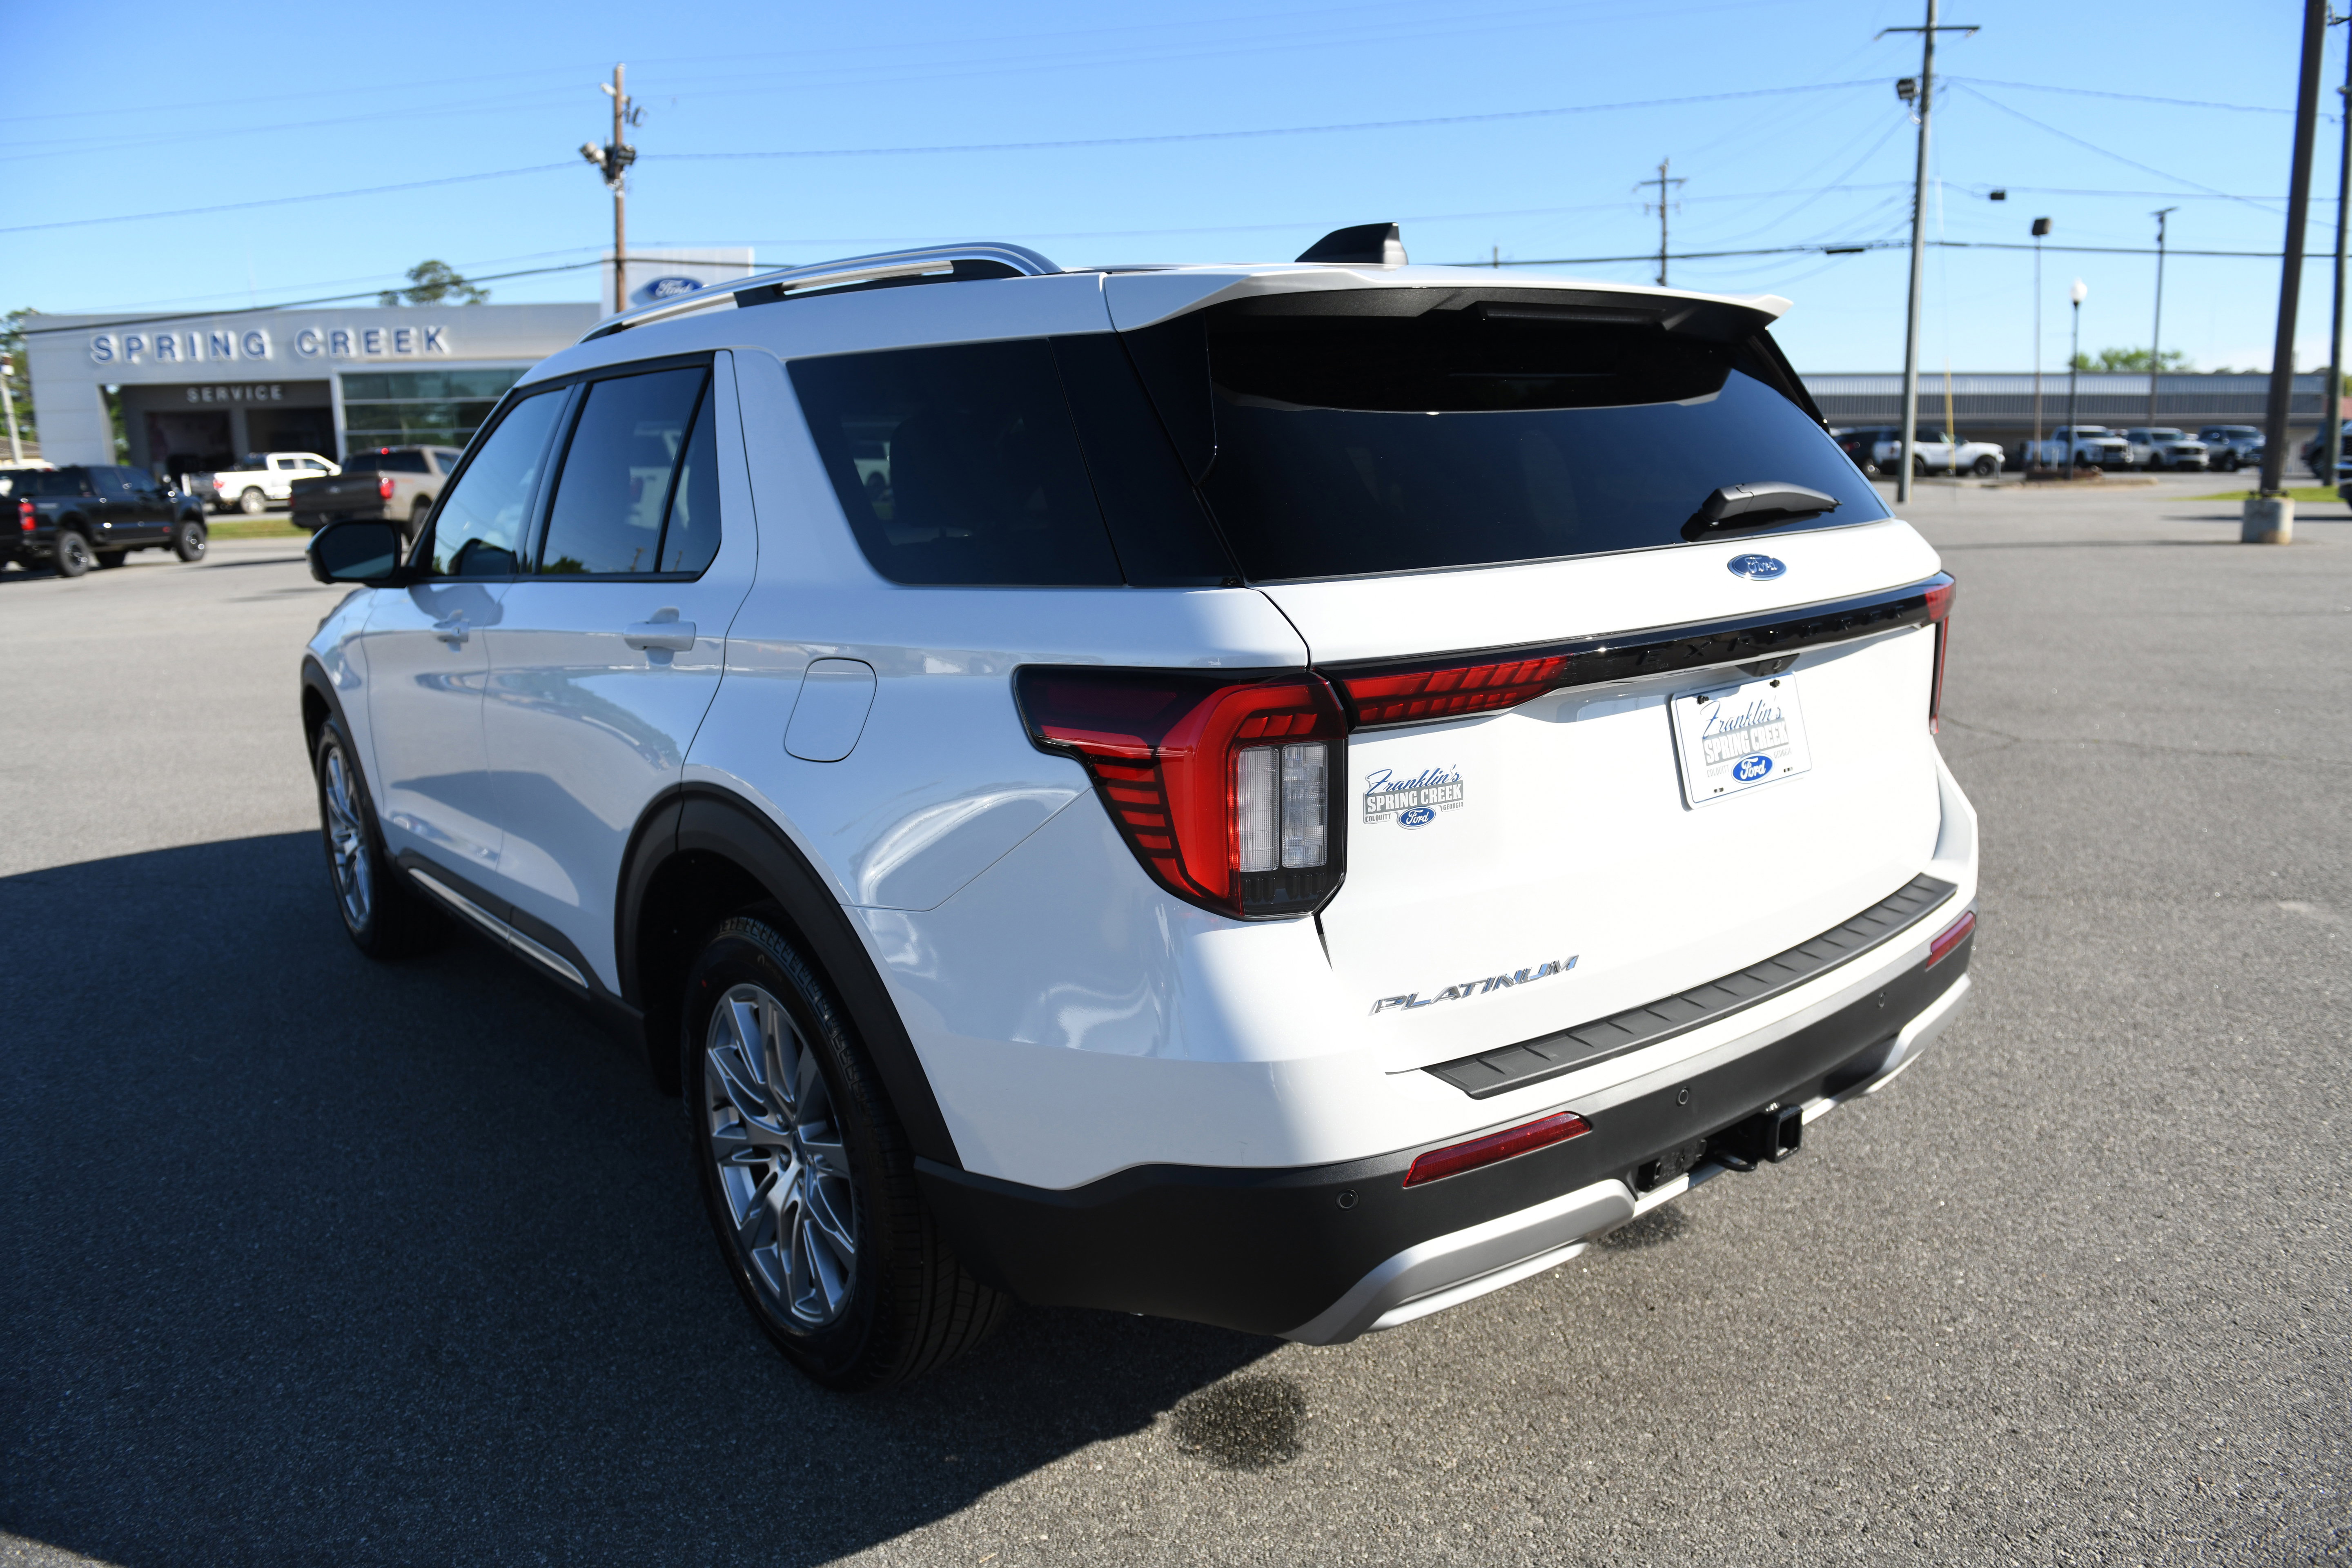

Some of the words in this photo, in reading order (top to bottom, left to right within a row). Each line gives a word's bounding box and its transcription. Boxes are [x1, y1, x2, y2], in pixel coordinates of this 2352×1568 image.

[90, 329, 273, 365] SPRING
[294, 326, 451, 359] CREEK
[187, 385, 284, 403] SERVICE
[1744, 556, 1778, 574] Ford
[1700, 695, 1782, 739] Franklin's
[1704, 731, 1751, 764] SPRING
[1750, 721, 1789, 751] CREEK
[1707, 764, 1729, 777] COLQUITT
[1774, 748, 1792, 759] GEORGIA
[1740, 757, 1766, 780] Ford
[1366, 764, 1462, 796] Franklin's
[1365, 813, 1392, 822] COLQUITT
[1443, 801, 1464, 810] GEORGIA
[1367, 790, 1418, 813] SPRING
[1421, 783, 1462, 806] CREEK
[1405, 809, 1430, 825] Ford
[1371, 953, 1579, 1014] PLATINUM
